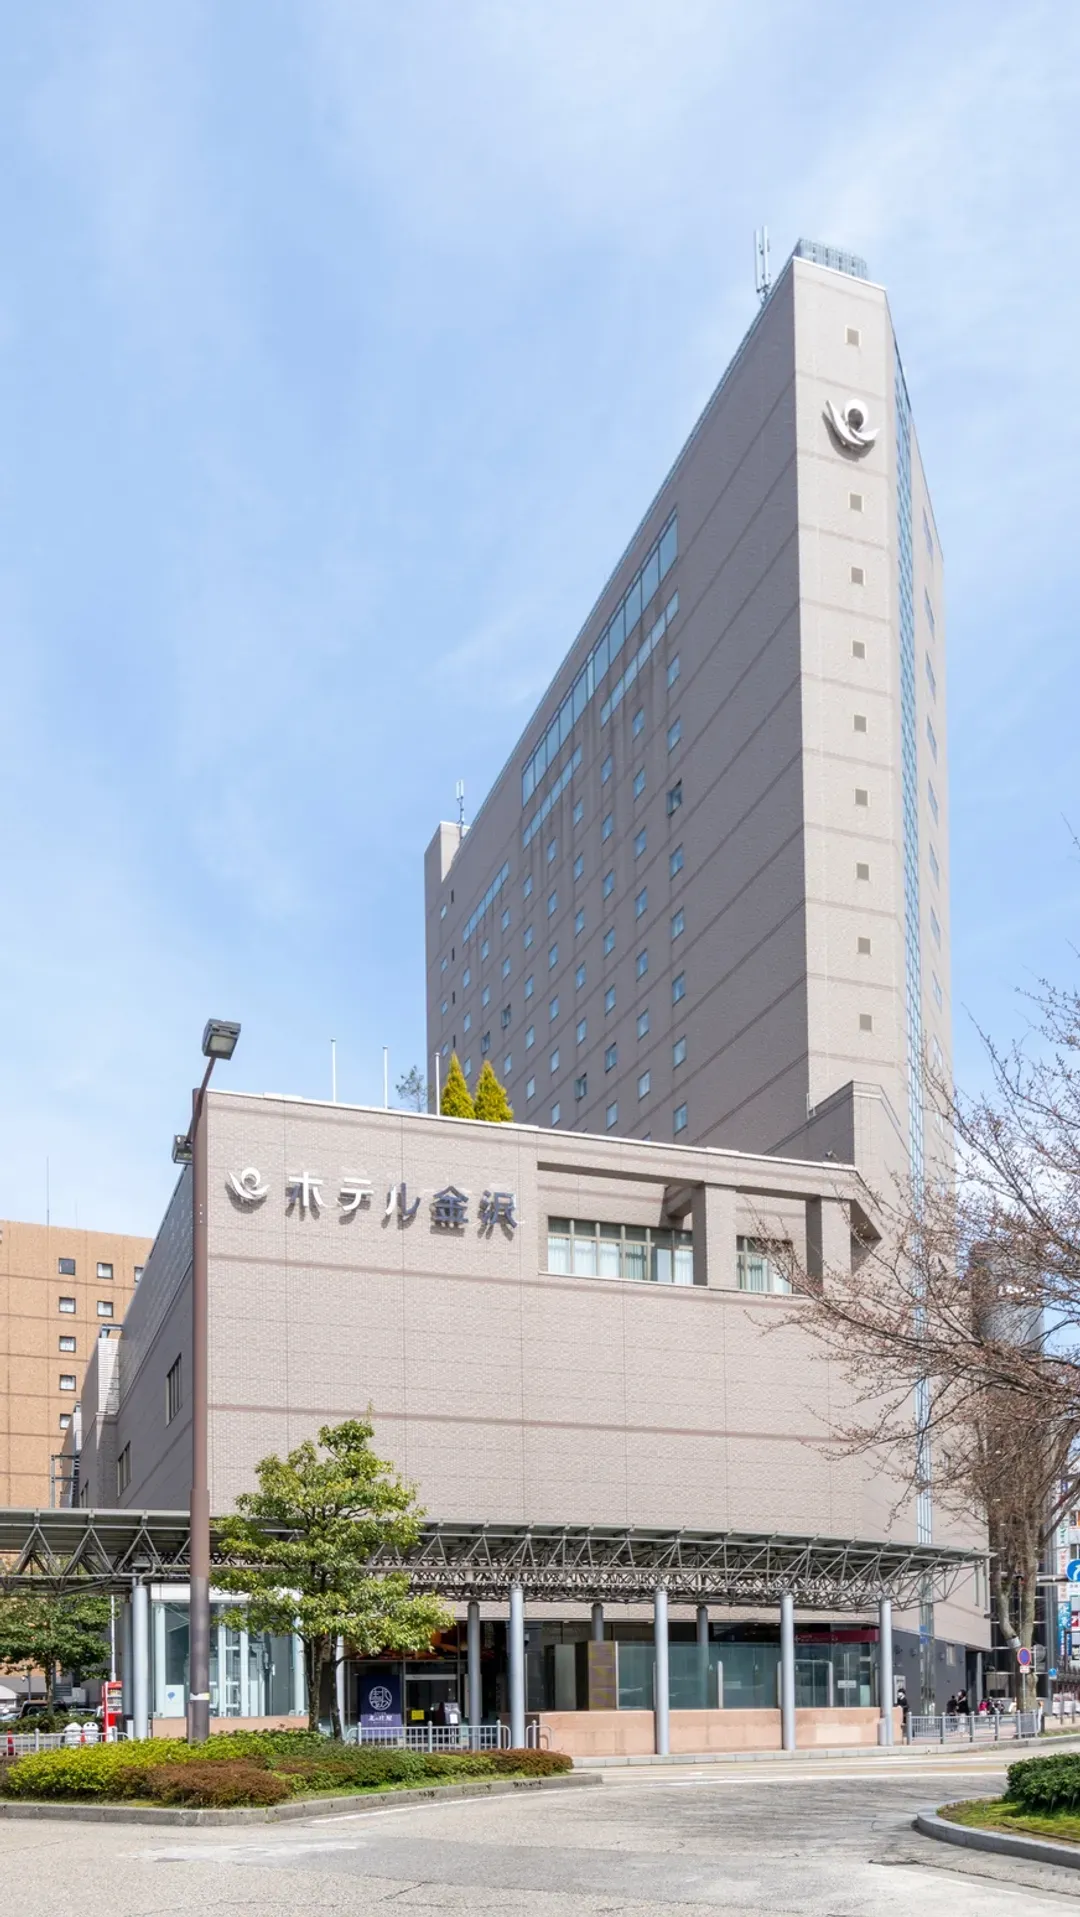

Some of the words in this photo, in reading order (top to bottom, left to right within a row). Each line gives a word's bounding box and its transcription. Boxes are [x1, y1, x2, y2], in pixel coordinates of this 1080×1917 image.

[286, 1171, 518, 1229] ホテル金沢
